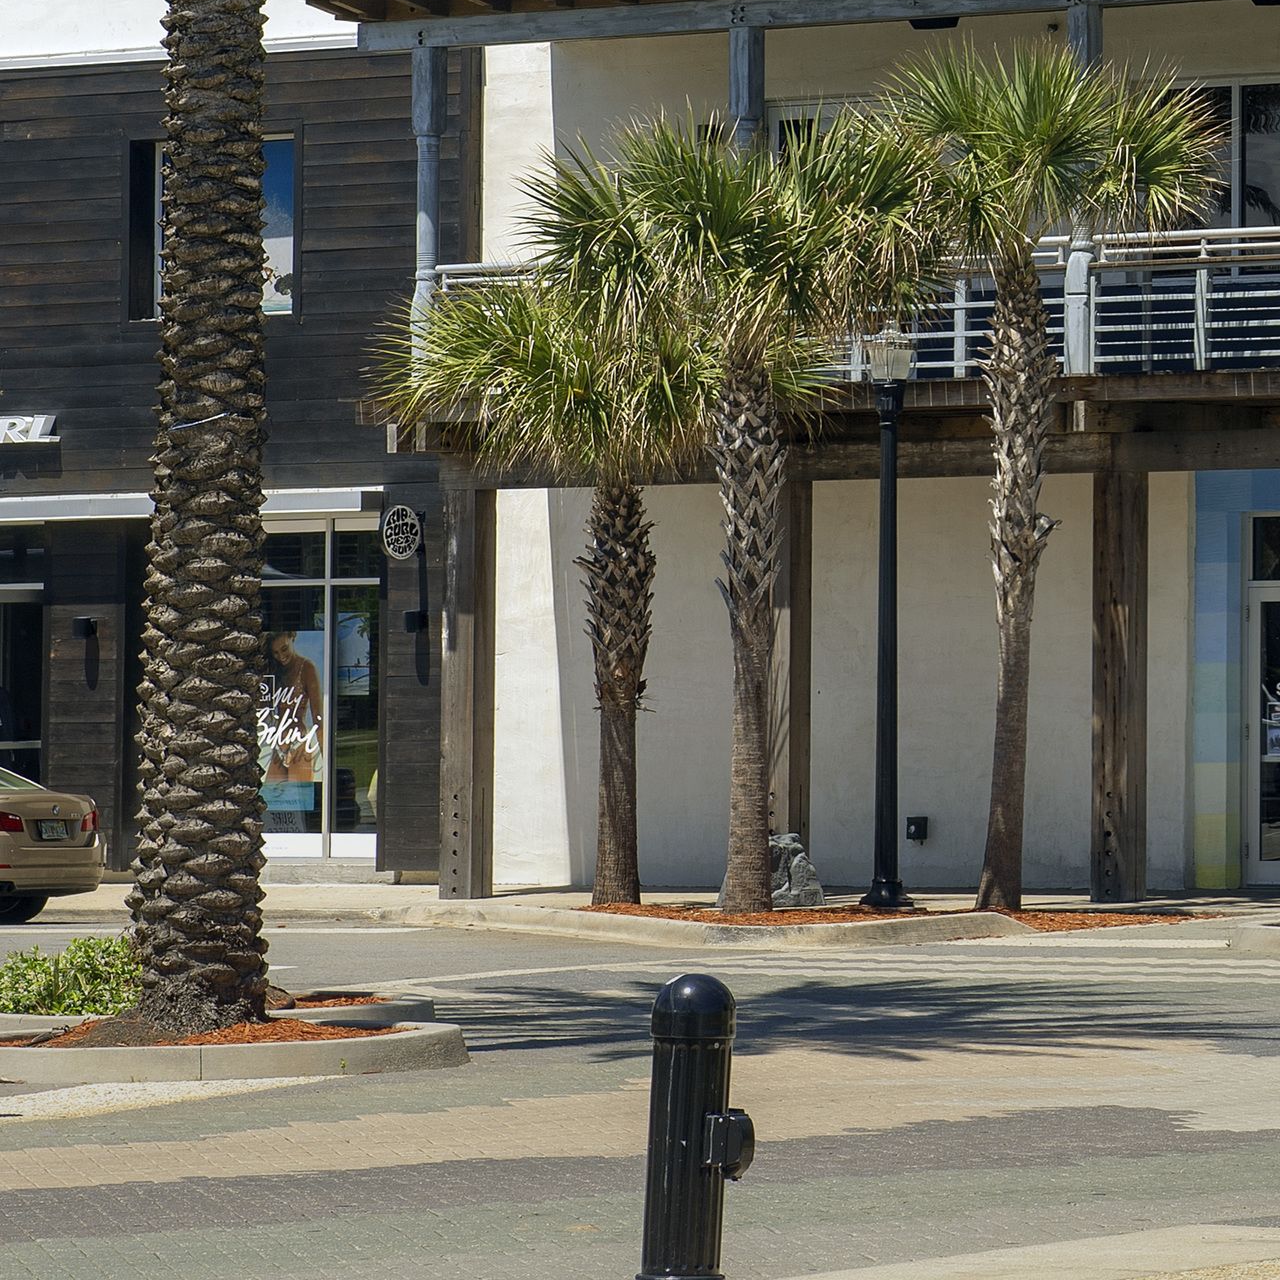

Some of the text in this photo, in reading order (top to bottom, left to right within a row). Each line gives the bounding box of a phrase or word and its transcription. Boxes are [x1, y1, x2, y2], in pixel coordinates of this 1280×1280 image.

[385, 522, 419, 539] CURL
[272, 686, 304, 720] My
[256, 707, 322, 753] Bikini
